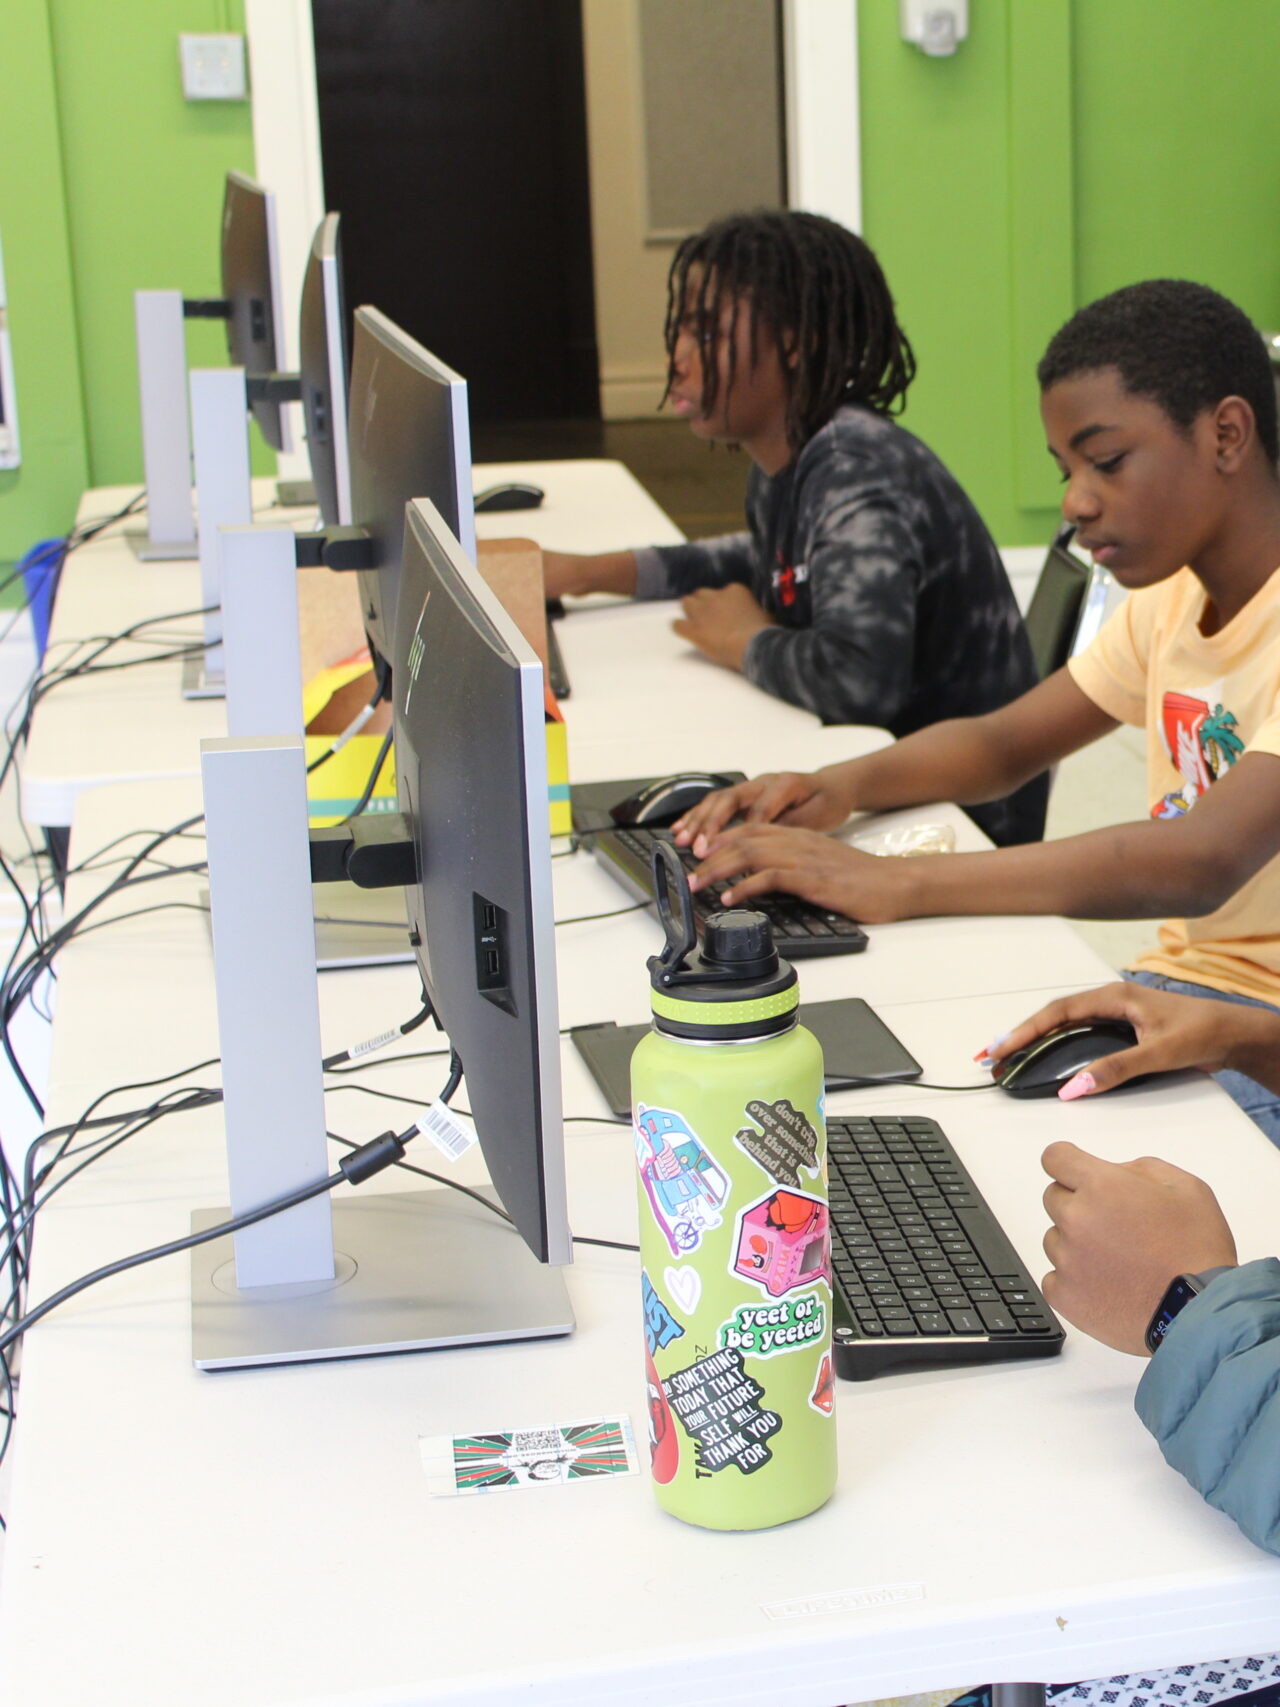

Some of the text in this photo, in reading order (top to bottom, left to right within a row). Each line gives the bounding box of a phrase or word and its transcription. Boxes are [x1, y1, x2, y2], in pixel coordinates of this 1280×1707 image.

[750, 1103, 777, 1127] over
[775, 1104, 815, 1148] don't trip
[739, 1132, 798, 1187] behind you
[764, 1134, 798, 1167] that is
[726, 1318, 822, 1351] be yeeted
[741, 1297, 815, 1331] yeet or
[672, 1348, 739, 1394] SOMETHING
[672, 1366, 746, 1416] TODAY THAT
[684, 1381, 760, 1428] YOUR FUTURE
[700, 1404, 758, 1446] SELF WILL
[704, 1412, 777, 1467] THANK YOU
[737, 1443, 768, 1469] FOR
